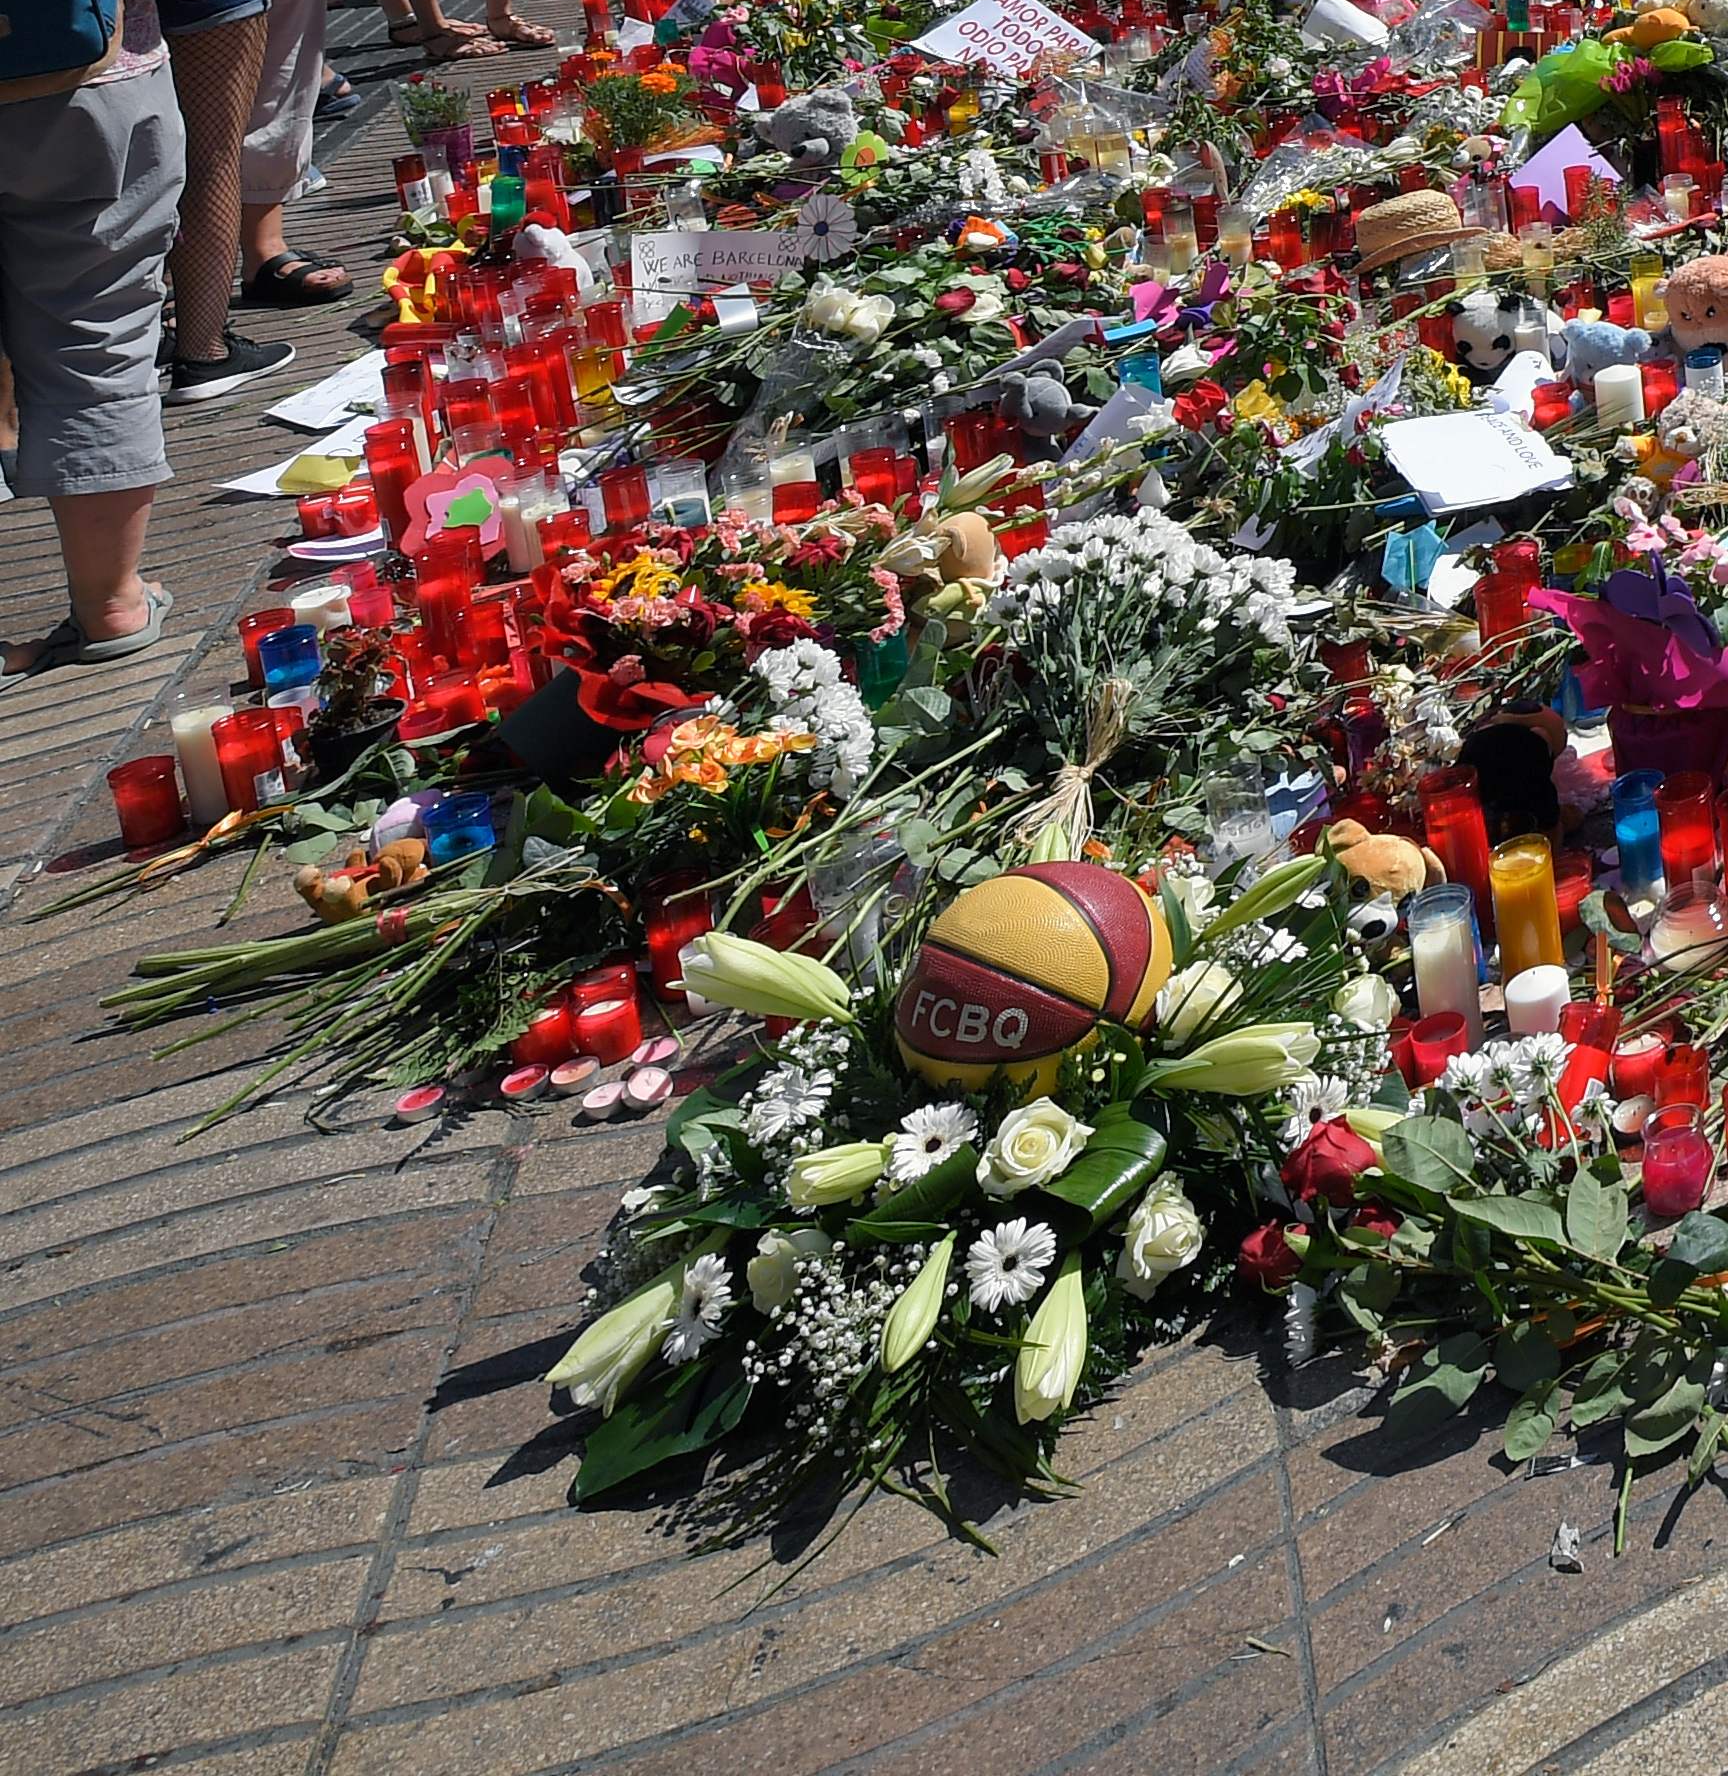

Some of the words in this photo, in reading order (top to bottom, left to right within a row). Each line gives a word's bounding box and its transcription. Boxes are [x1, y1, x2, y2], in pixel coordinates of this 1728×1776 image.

[958, 20, 1007, 56] ODIO
[993, 15, 1045, 56] TODO
[642, 256, 668, 276] WE
[673, 252, 704, 269] ARE
[712, 250, 805, 268] BARCELONA
[1500, 428, 1522, 450] AND
[1516, 443, 1544, 471] LOVE
[909, 988, 1030, 1053] FCBQ
